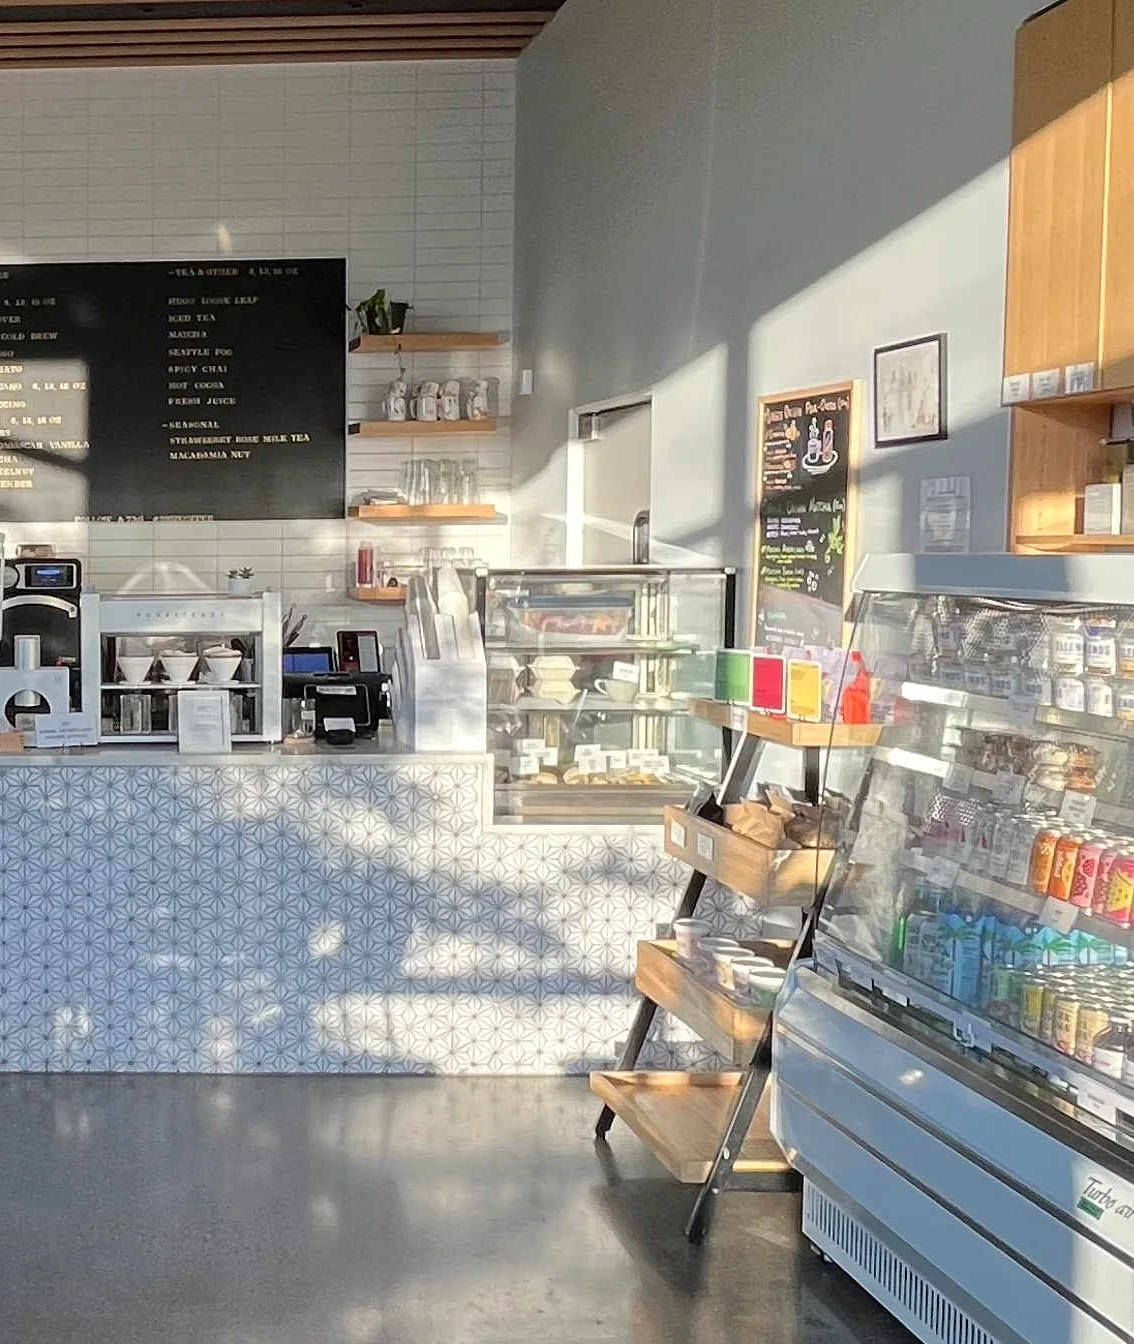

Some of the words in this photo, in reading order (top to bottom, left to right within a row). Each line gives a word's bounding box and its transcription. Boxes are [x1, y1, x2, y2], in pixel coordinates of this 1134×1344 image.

[168, 314, 192, 323] ICED
[197, 313, 216, 323] TEA
[0, 333, 25, 341] COLD
[30, 332, 59, 341] BREW
[168, 330, 208, 339] MATCHA
[168, 348, 210, 357] SEATTLE
[214, 348, 233, 357] FOG
[167, 365, 198, 373] SPICY
[201, 364, 228, 373] CHAI
[168, 381, 188, 390] HOT
[194, 381, 225, 389] COCOA
[167, 397, 201, 405] FRESH
[206, 397, 236, 405] JUICE
[169, 435, 233, 444] STRAWBERRY
[235, 435, 260, 444] ROSE
[262, 434, 288, 443] MILK
[290, 433, 310, 442] TEA
[49, 440, 90, 449] VANILLA
[169, 451, 228, 460] MACADAMIA
[230, 451, 251, 459] NUT
[1083, 1176, 1117, 1210] Turbo
